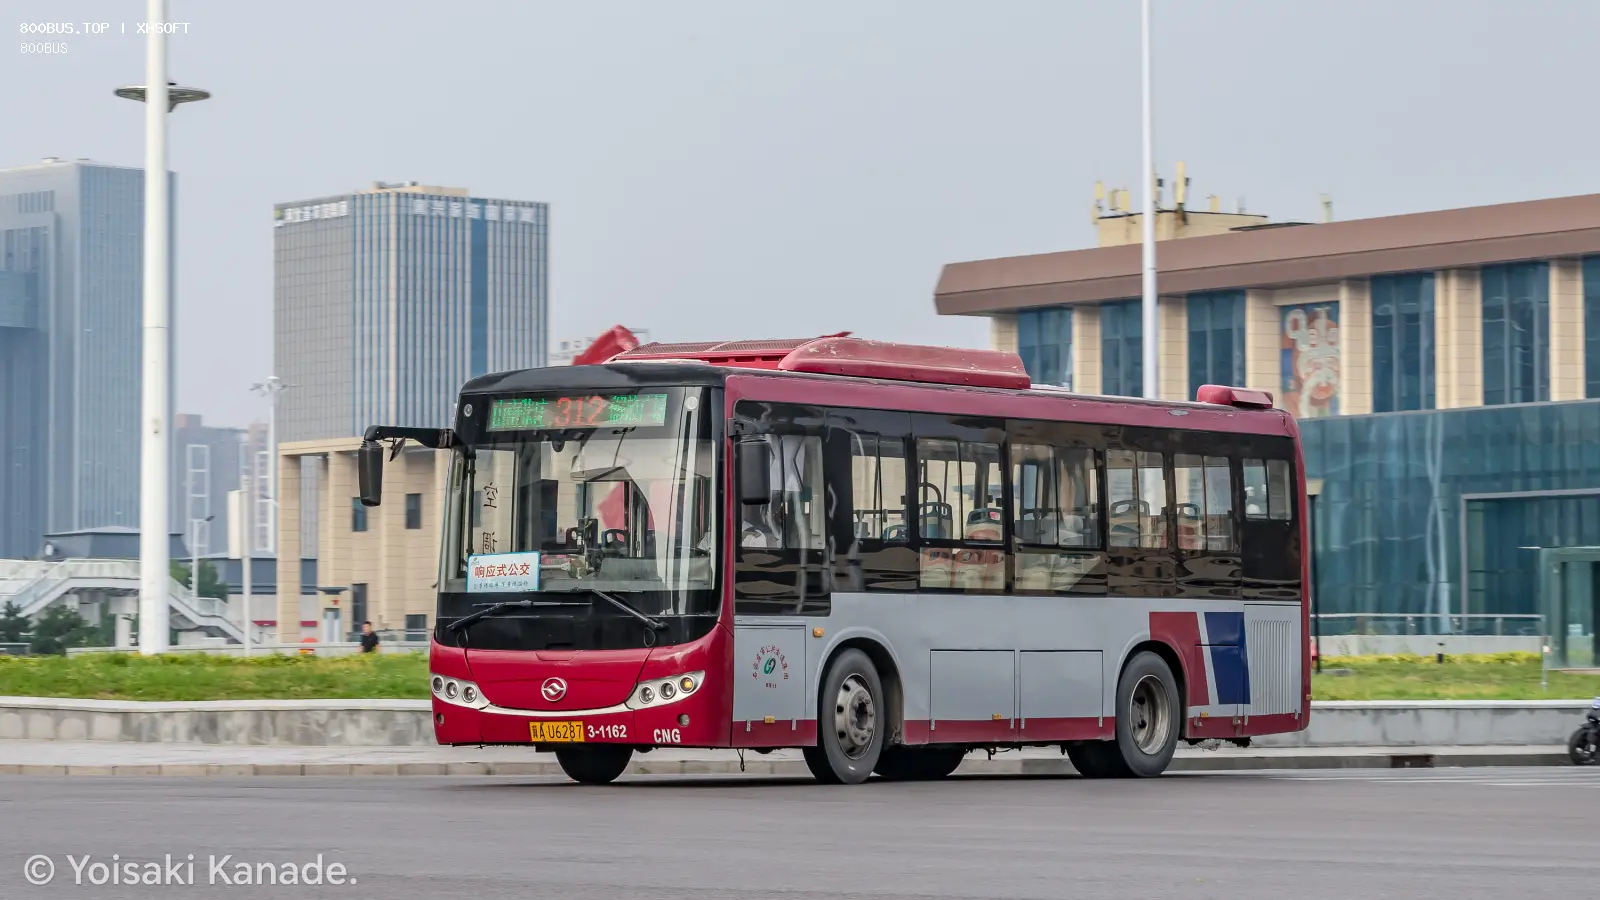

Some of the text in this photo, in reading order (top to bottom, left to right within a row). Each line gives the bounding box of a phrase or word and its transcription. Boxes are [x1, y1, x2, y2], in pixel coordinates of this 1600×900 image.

[555, 396, 605, 427] 312
[474, 563, 531, 579] 响应式公交
[587, 724, 628, 739] 3-1162
[653, 728, 681, 744] CNG
